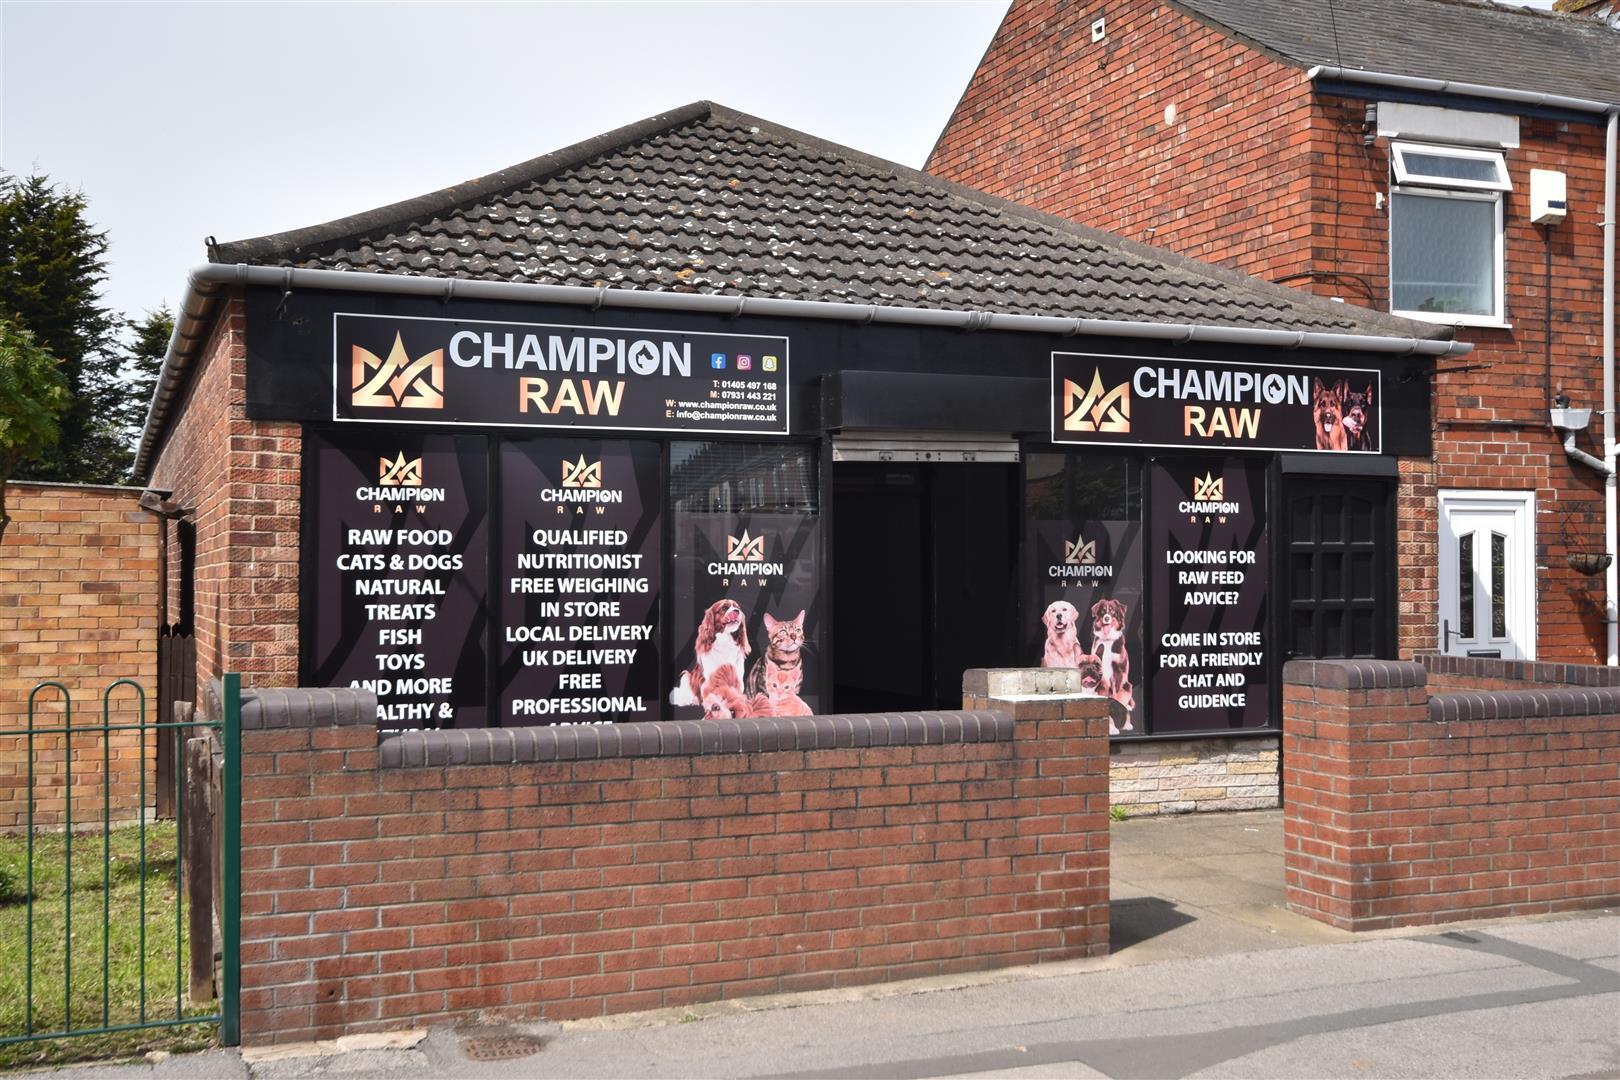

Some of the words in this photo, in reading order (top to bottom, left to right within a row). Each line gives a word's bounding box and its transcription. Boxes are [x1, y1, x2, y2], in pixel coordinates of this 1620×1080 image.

[449, 330, 691, 376] CHAMPION
[721, 380, 745, 389] 01405
[747, 381, 761, 390] 497
[1133, 366, 1309, 405] CHAMPION
[520, 377, 625, 416] RAW
[721, 390, 744, 400] 07931
[746, 391, 761, 400] 443
[762, 392, 776, 401] 221
[678, 401, 777, 411] www.championraw.co.uk
[676, 410, 777, 421] info@championraw.co.uk
[1185, 406, 1261, 438] RAW
[356, 487, 444, 501] CHAMPION
[541, 488, 622, 503] CHAMPION
[1179, 501, 1239, 513] CHAMPION
[349, 529, 393, 545] RAW
[398, 530, 452, 545] FOOD
[533, 530, 627, 546] QUALIFIED
[337, 554, 385, 570] CATS
[390, 554, 404, 570] &
[409, 554, 463, 570] DOGS
[518, 554, 642, 569] NUTRITIONIST
[1167, 551, 1227, 563] LOOKING
[1230, 551, 1255, 563] FOR
[708, 562, 783, 575] CHAMPION
[1049, 566, 1112, 576] CHAMPION
[1179, 571, 1209, 584] RAW
[1212, 571, 1244, 584] FEED
[356, 579, 445, 595] NATURAL
[511, 578, 554, 593] FREE
[557, 578, 648, 593] WEIGHING
[1184, 592, 1239, 605] ADVICE?
[365, 604, 435, 620] TREATS
[541, 602, 559, 617] IN
[564, 602, 620, 617] STORE
[380, 629, 421, 645] FISH
[506, 626, 565, 642] LOCAL
[569, 625, 652, 641] DELIVERY
[1162, 633, 1200, 647] COME
[1203, 633, 1217, 646] IN
[1220, 632, 1260, 645] STORE
[376, 654, 425, 670] TOYS
[523, 651, 548, 666] UK
[553, 649, 637, 665] DELIVERY
[1160, 654, 1187, 667] FOR
[1189, 654, 1199, 667] A
[1202, 652, 1262, 666] FRIENDLY
[396, 678, 452, 694] MORE
[560, 674, 601, 689] FREE
[1179, 674, 1213, 688] CHAT
[1216, 673, 1245, 686] AND
[512, 696, 646, 715] PROFESSIONAL
[1179, 694, 1245, 708] GUIDENCE
[376, 703, 435, 720] ALTHY
[438, 703, 453, 718] &
